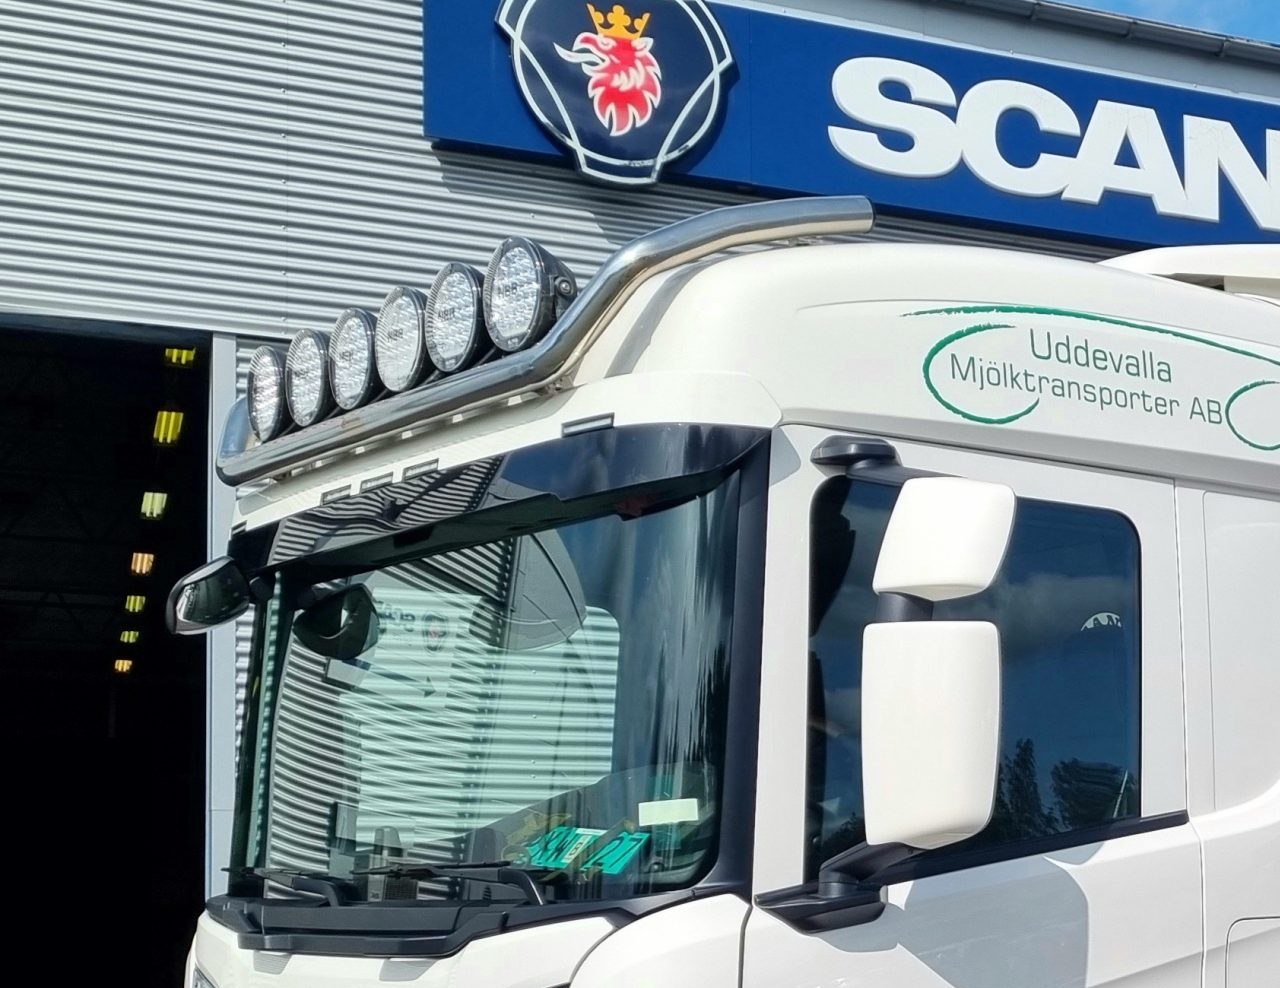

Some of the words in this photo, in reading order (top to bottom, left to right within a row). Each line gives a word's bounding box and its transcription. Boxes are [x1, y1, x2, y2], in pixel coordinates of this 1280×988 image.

[1029, 327, 1173, 383] Uddevalla
[949, 352, 1180, 417] Mjölktransporter
[1188, 396, 1223, 425] AB
